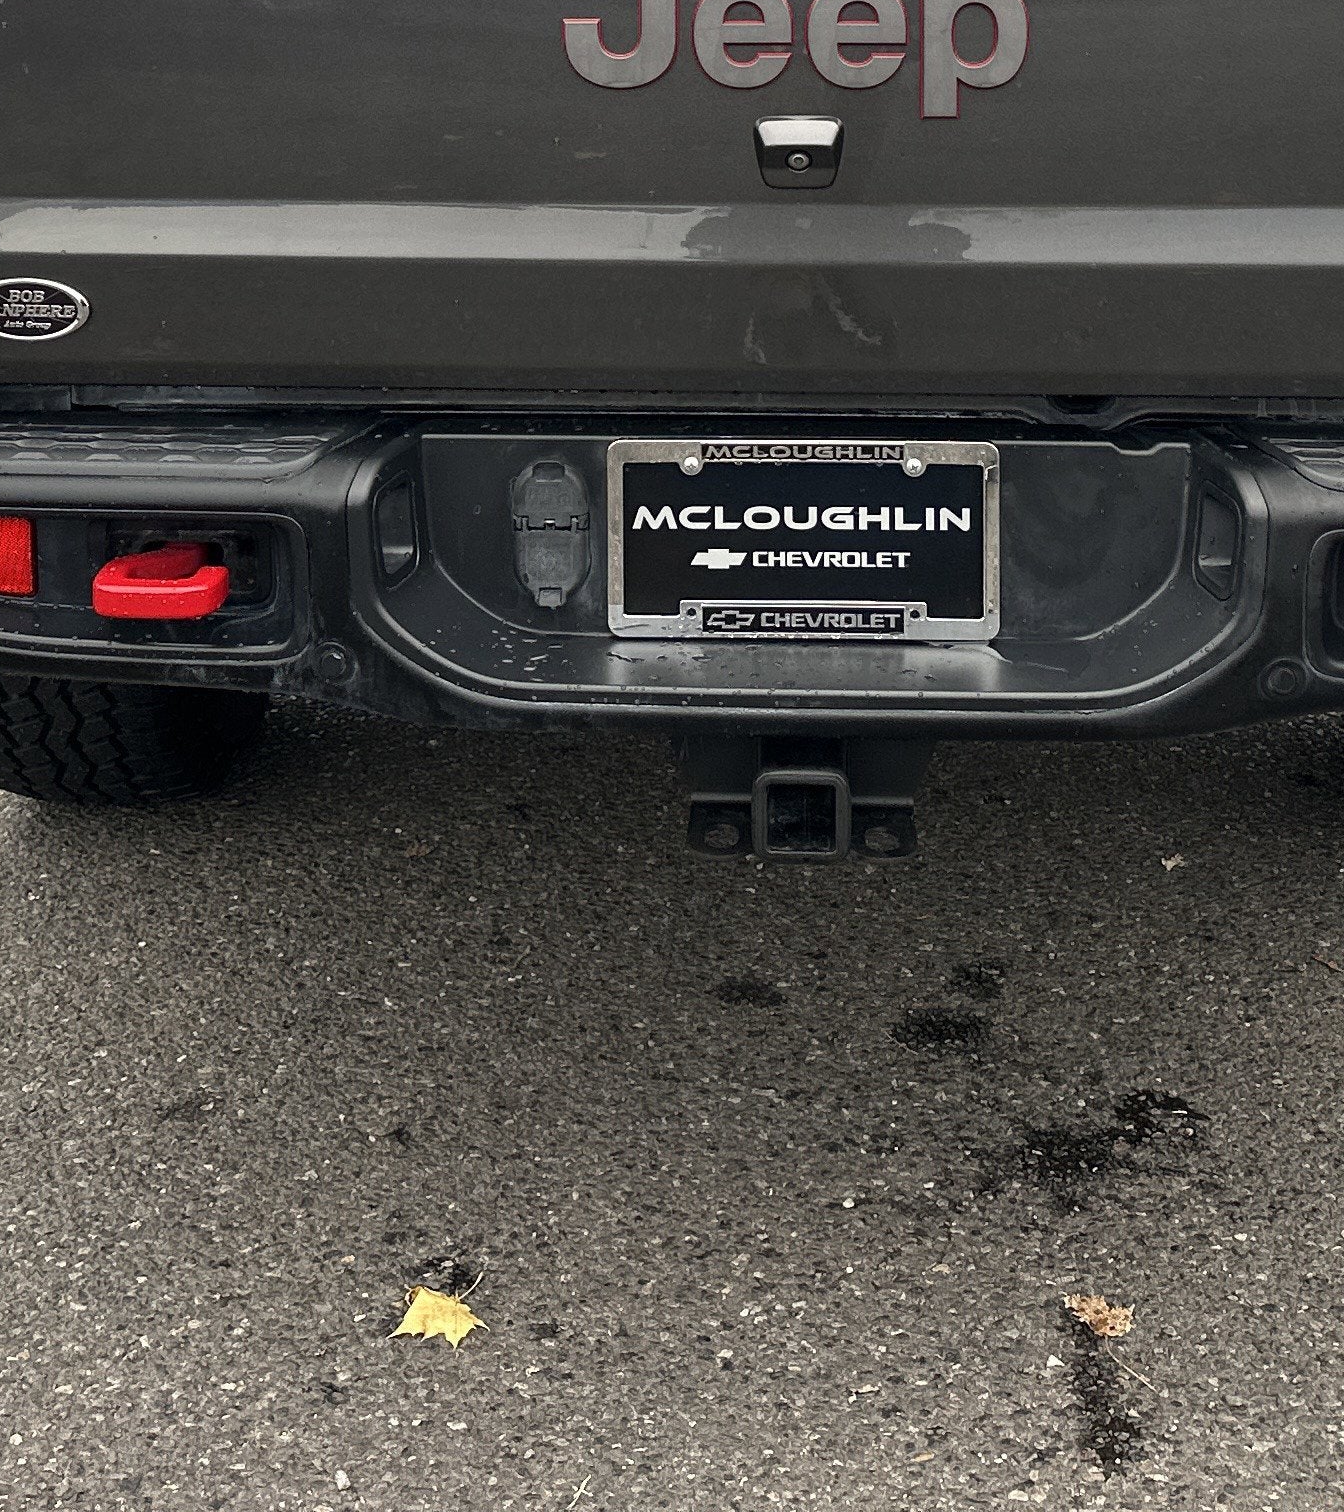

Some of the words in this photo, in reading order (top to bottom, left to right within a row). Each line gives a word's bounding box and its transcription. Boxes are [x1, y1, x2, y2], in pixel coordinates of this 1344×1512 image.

[8, 289, 46, 303] BOB
[704, 444, 903, 461] MCLOUGHLIN
[632, 505, 971, 532] MCLOUGHLIN
[752, 551, 911, 568] CHEVROLET
[759, 612, 902, 629] CHEVROLET
